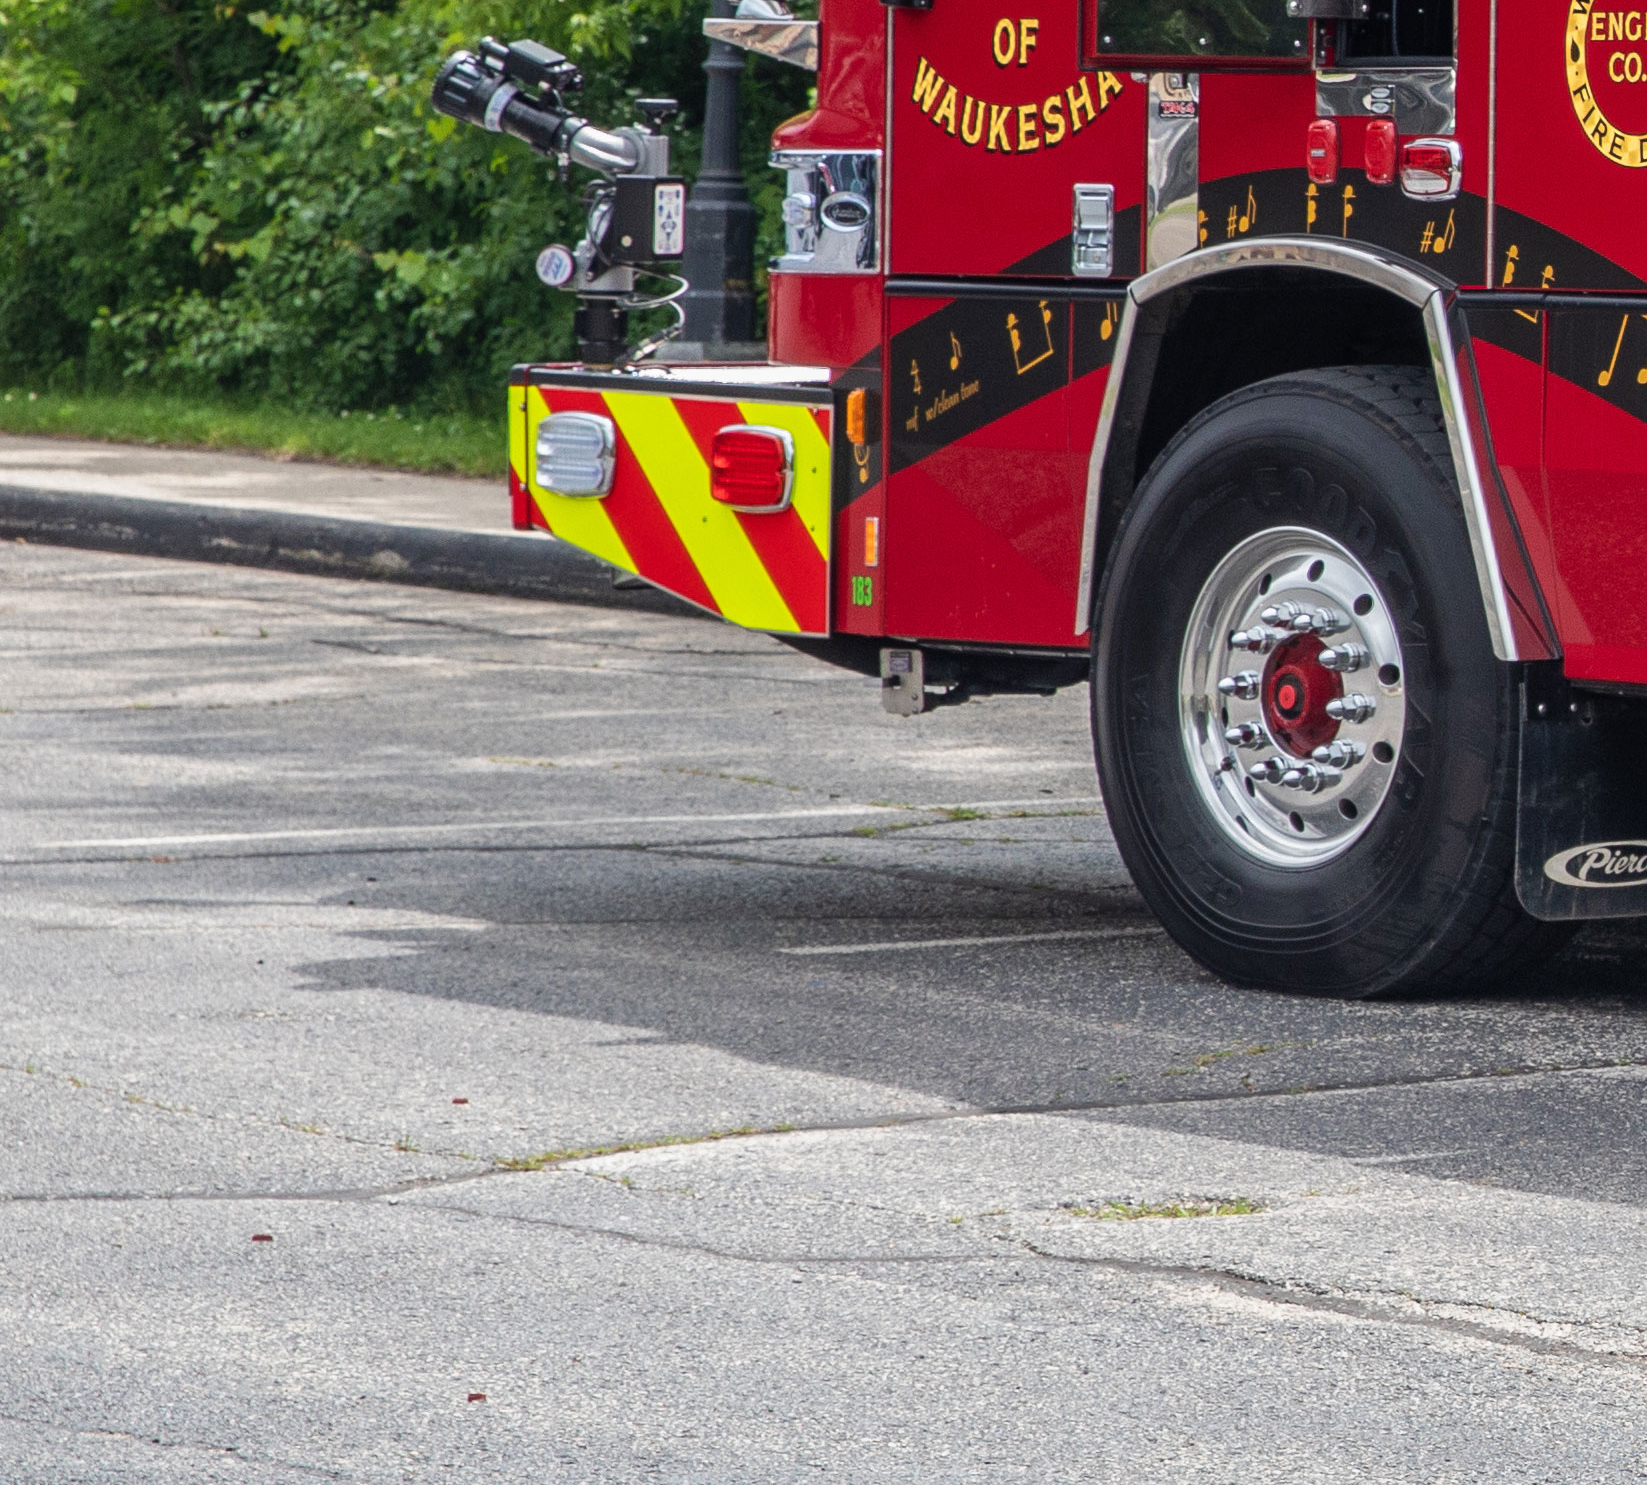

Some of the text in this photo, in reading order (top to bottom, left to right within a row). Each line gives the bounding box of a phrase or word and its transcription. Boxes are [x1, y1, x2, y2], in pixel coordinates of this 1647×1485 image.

[993, 18, 1040, 67] OF
[1608, 52, 1647, 83] CO.
[911, 56, 1124, 154] WAUKESHA
[1573, 83, 1626, 160] FIRE
[852, 576, 873, 607] 183
